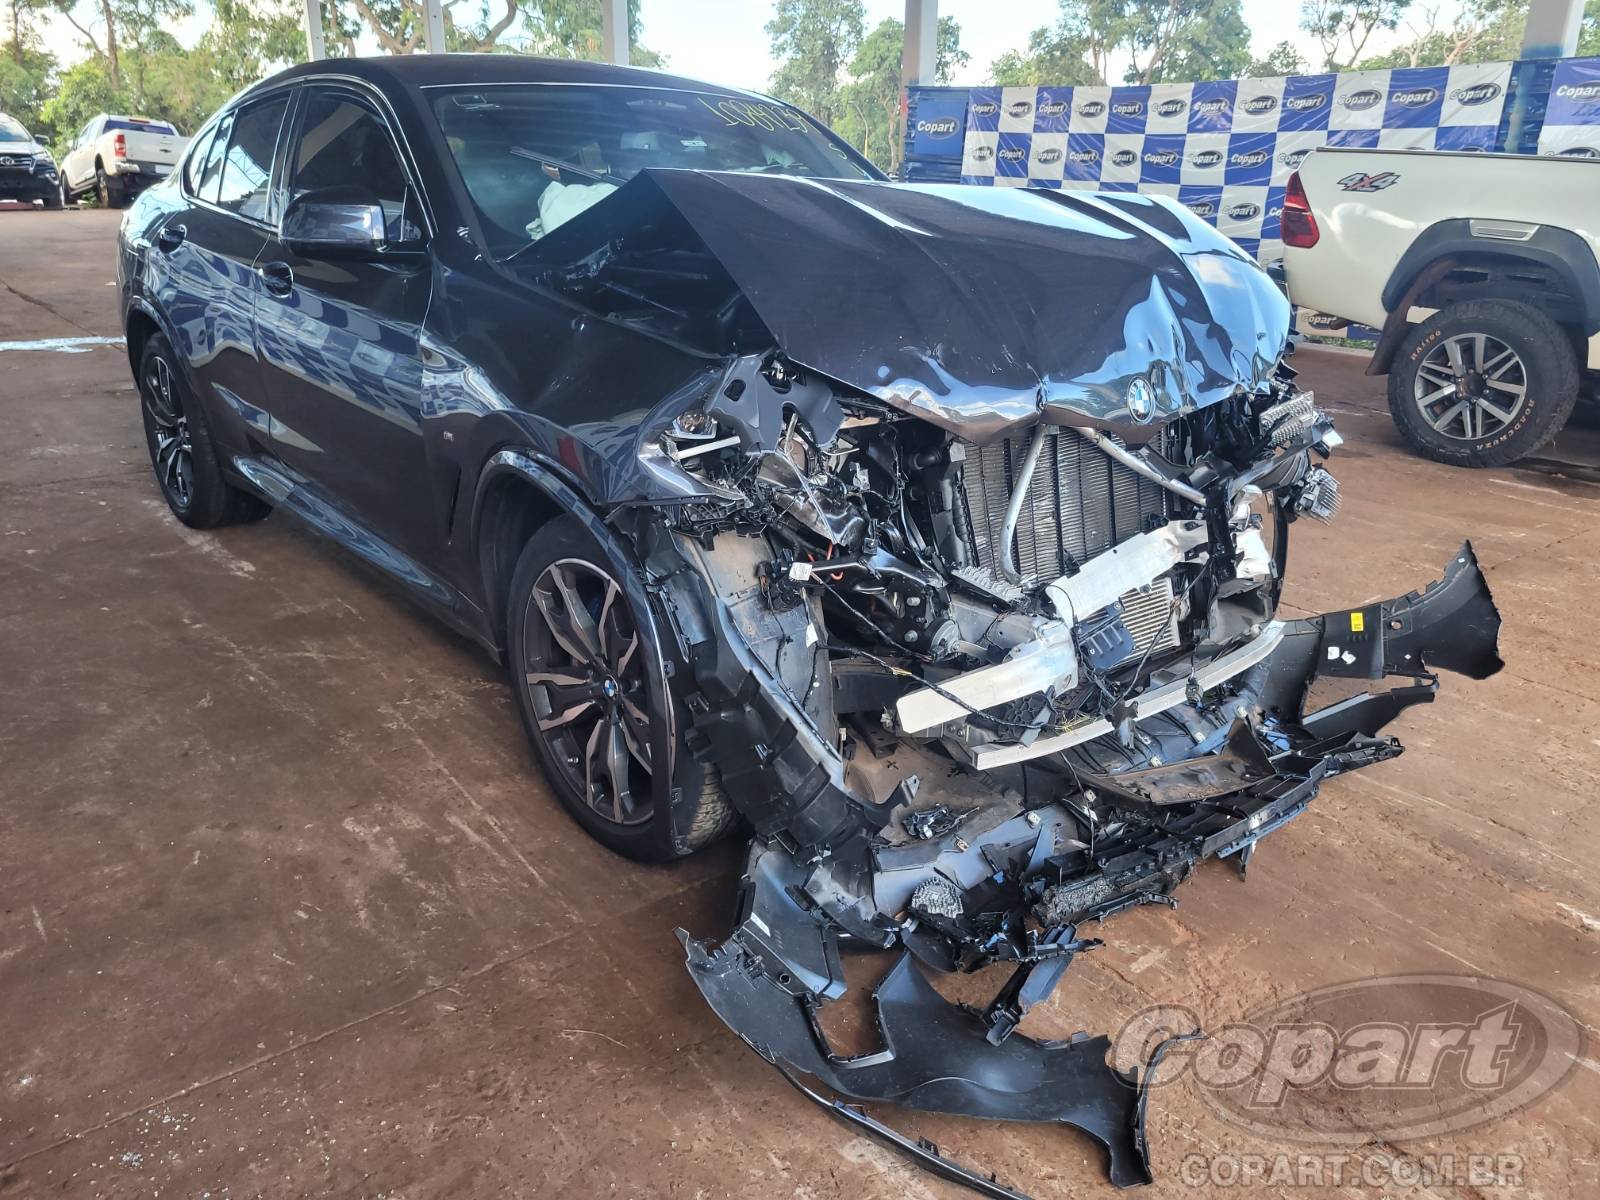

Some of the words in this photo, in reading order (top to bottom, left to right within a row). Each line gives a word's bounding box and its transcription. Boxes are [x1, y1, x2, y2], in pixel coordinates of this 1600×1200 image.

[1391, 89, 1434, 104] Copart
[1449, 86, 1494, 101] Copart
[1556, 84, 1600, 99] Copar
[1239, 98, 1273, 111] Copart
[1286, 94, 1323, 111] Copart
[1337, 91, 1378, 107] Copart
[971, 103, 995, 115] Copart
[1038, 103, 1065, 115] Copart
[1112, 103, 1140, 116] Copart
[1151, 101, 1182, 115] Copart
[1193, 100, 1226, 113] Copart
[917, 120, 955, 134] Copart
[999, 149, 1022, 160] Copart
[1069, 151, 1095, 162] Copart
[1144, 153, 1175, 165] Copart
[1231, 153, 1264, 166] Copart
[1278, 153, 1304, 166] Copa
